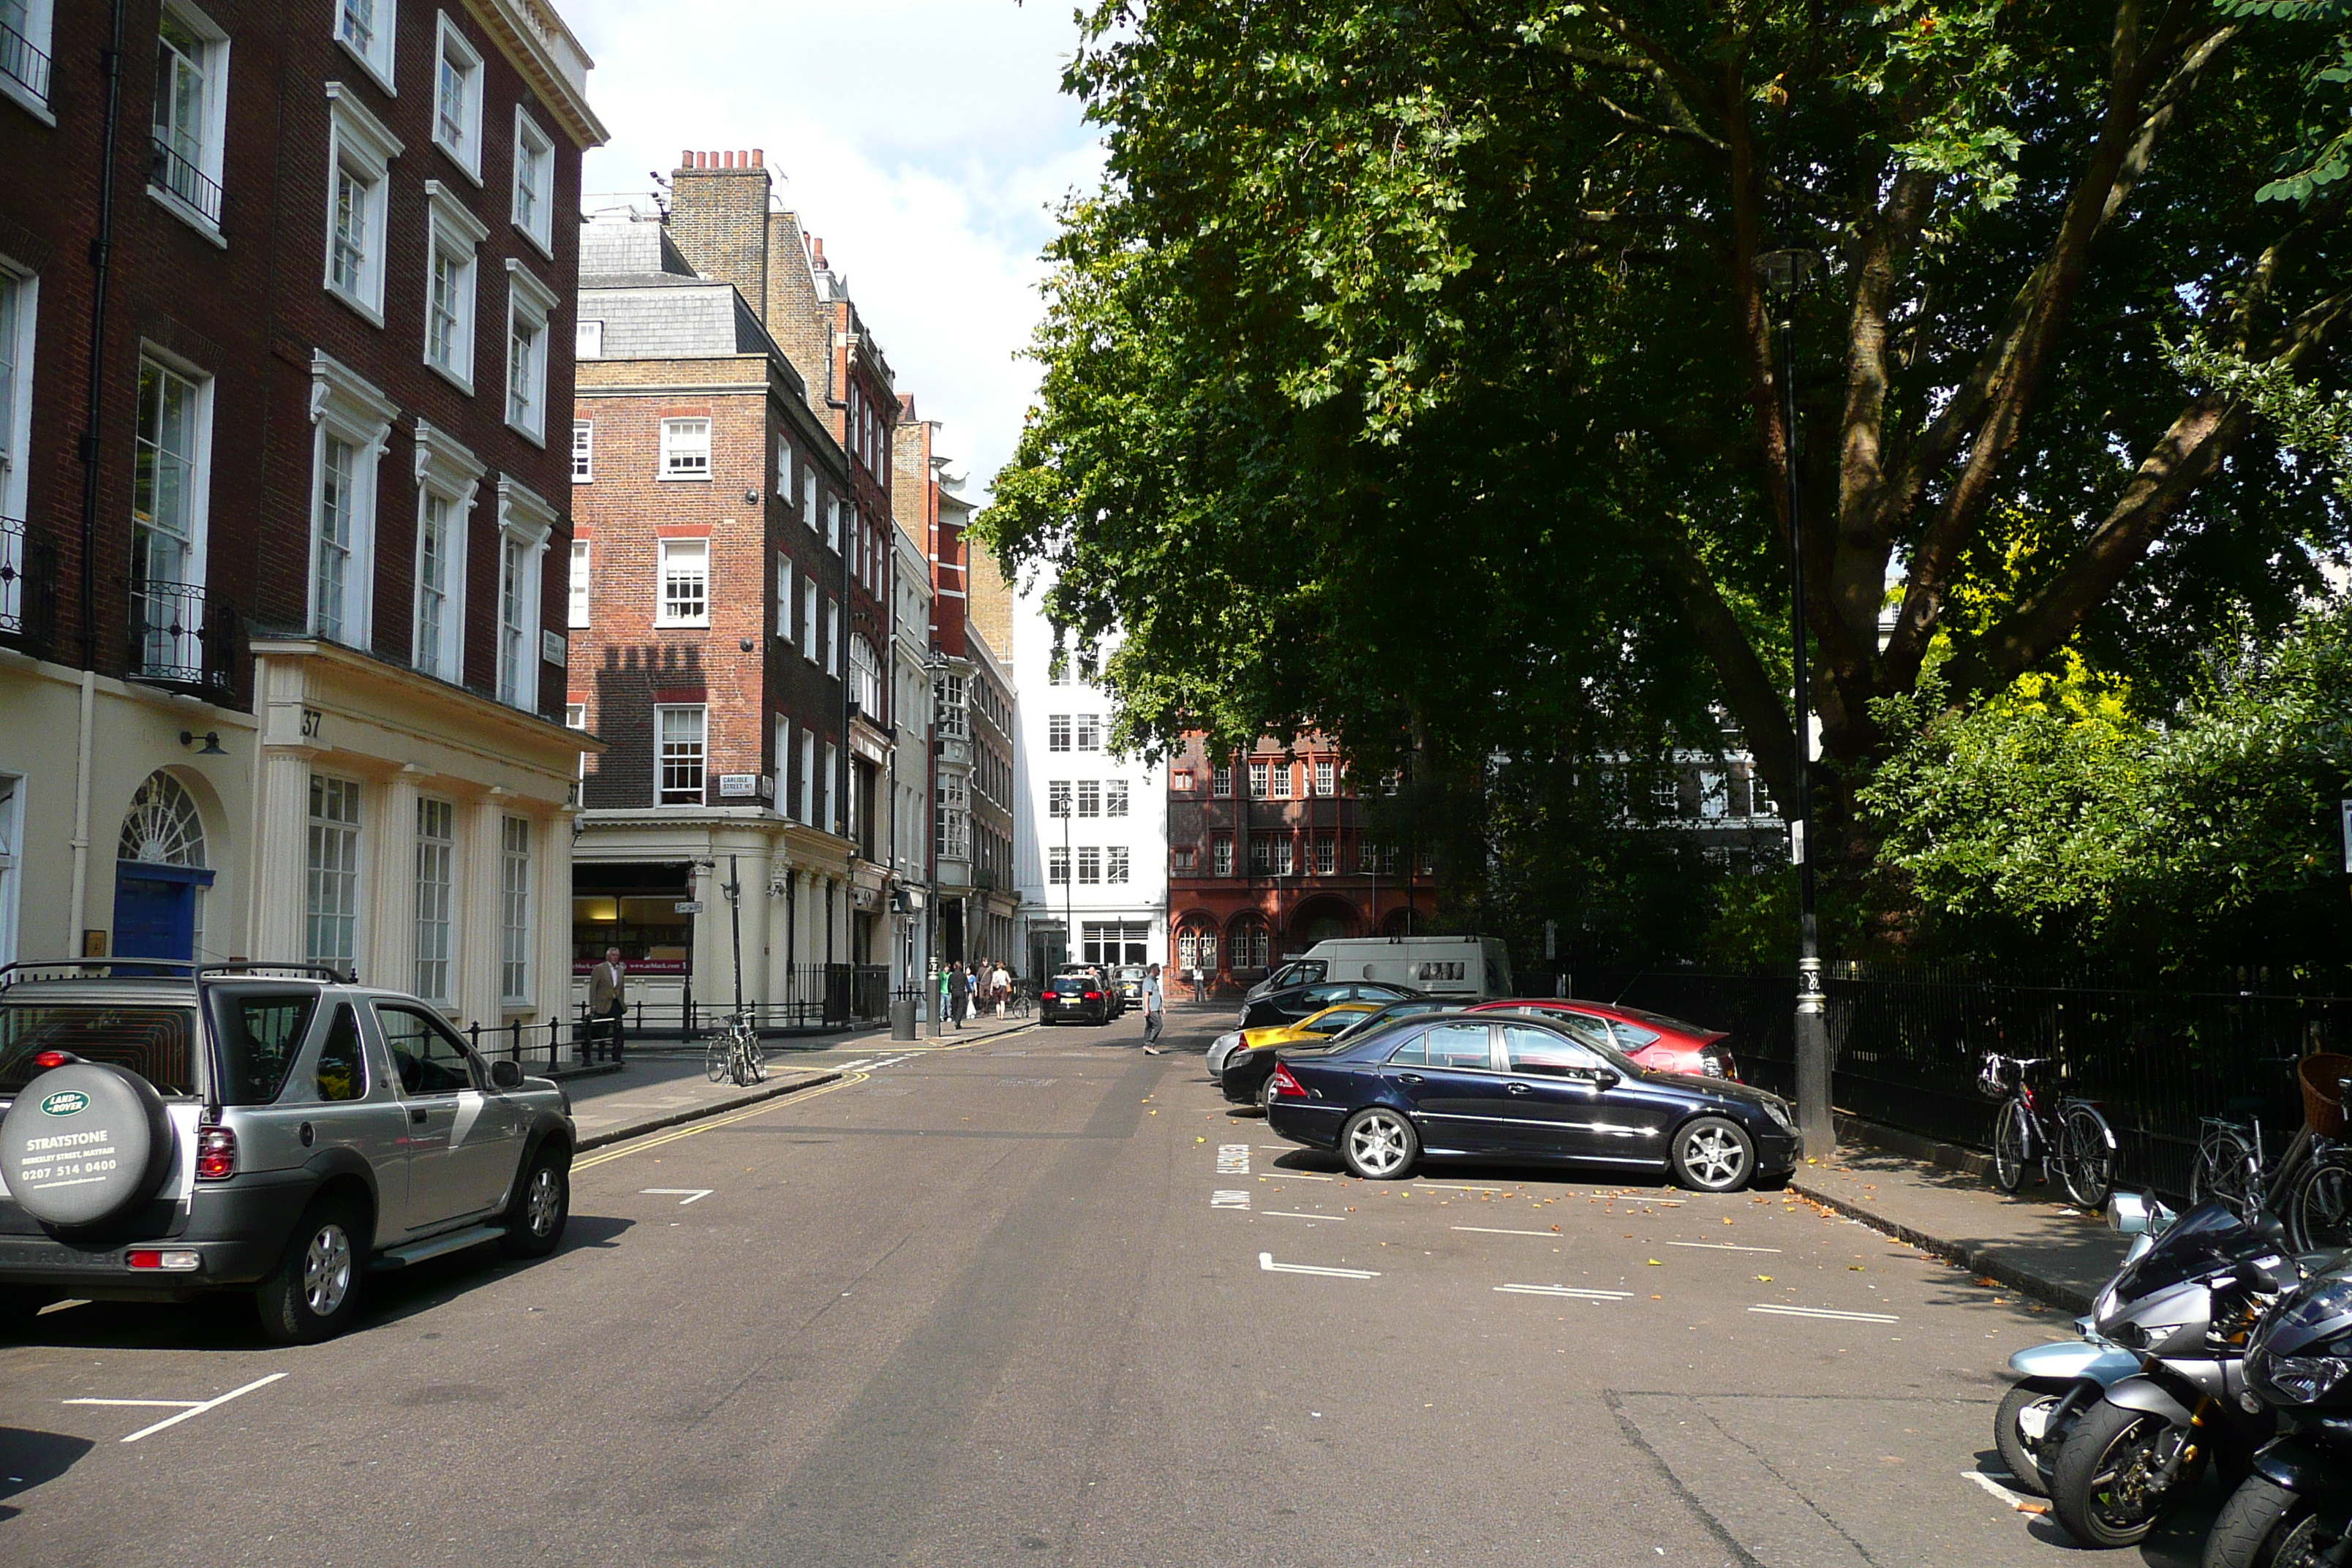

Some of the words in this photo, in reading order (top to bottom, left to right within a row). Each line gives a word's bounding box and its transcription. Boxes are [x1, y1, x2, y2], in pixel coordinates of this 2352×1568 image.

[302, 709, 322, 739] 37
[568, 783, 579, 804] 37
[49, 1094, 75, 1105] LAND
[52, 1101, 83, 1113] ROVER
[26, 1130, 108, 1152] STRATSTONE
[21, 1154, 56, 1166] BERKELEY
[56, 1151, 83, 1161] STREET,
[83, 1147, 116, 1158] MAYFAIR
[22, 1168, 51, 1181] 0207
[56, 1164, 80, 1177] 514
[85, 1159, 117, 1173] 0400
[1210, 1190, 1251, 1210] ONLY
